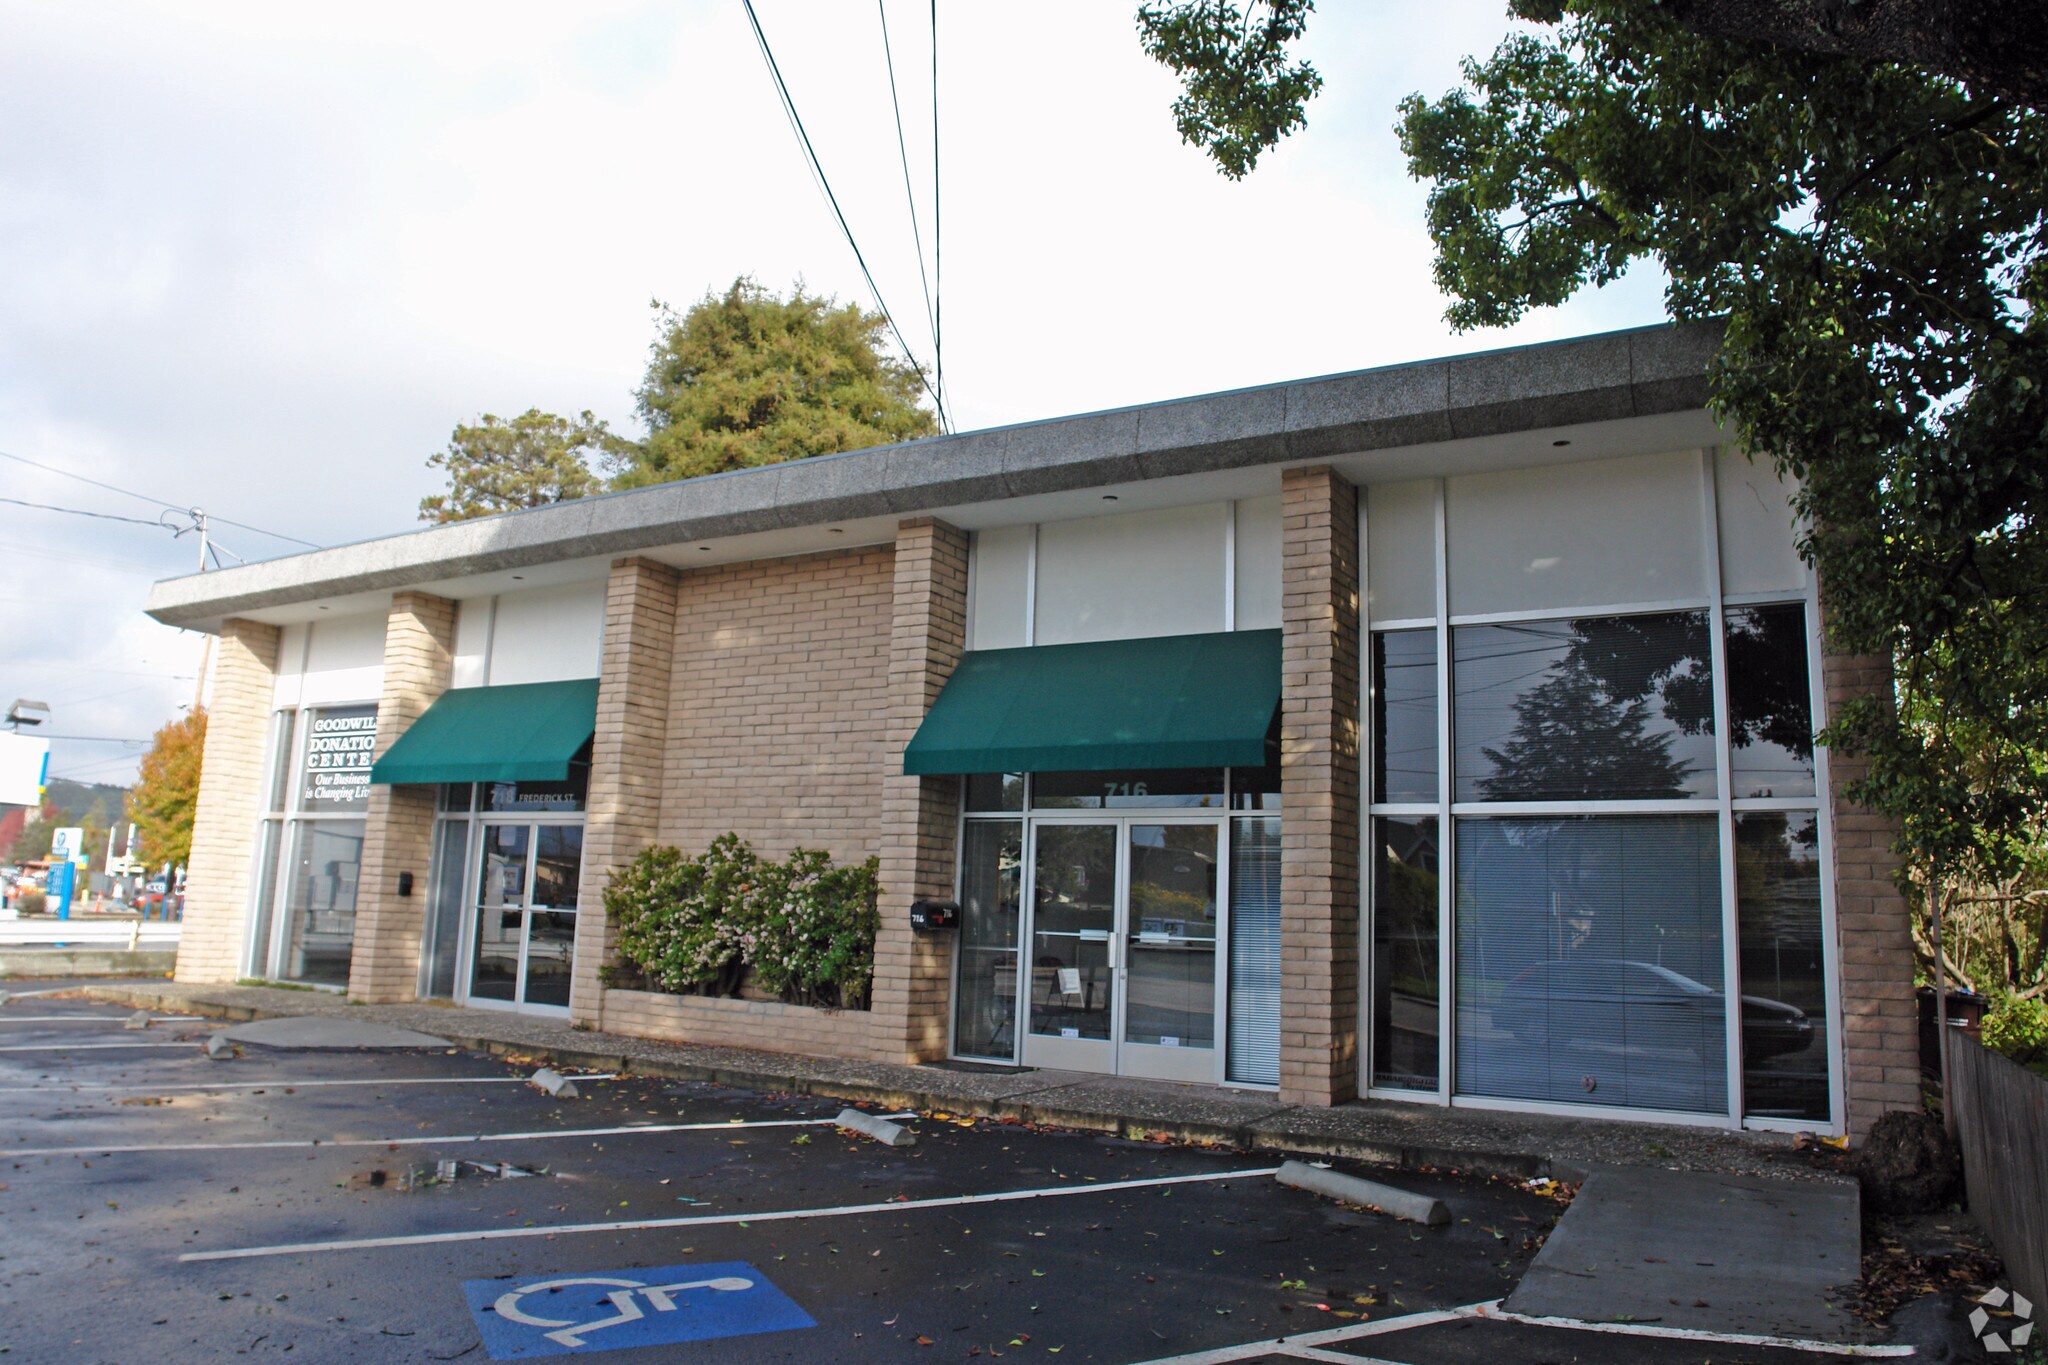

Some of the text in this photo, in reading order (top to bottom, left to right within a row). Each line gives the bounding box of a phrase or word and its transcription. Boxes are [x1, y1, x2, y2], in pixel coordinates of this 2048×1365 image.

[314, 717, 377, 732] GOODWIL
[309, 736, 375, 752] DONATIO
[307, 752, 370, 768] CENTE
[315, 773, 370, 785] Our Business
[305, 786, 369, 802] is Changing Liv
[519, 793, 562, 803] FREDERICK
[1104, 781, 1148, 801] 716
[911, 914, 924, 923] 716
